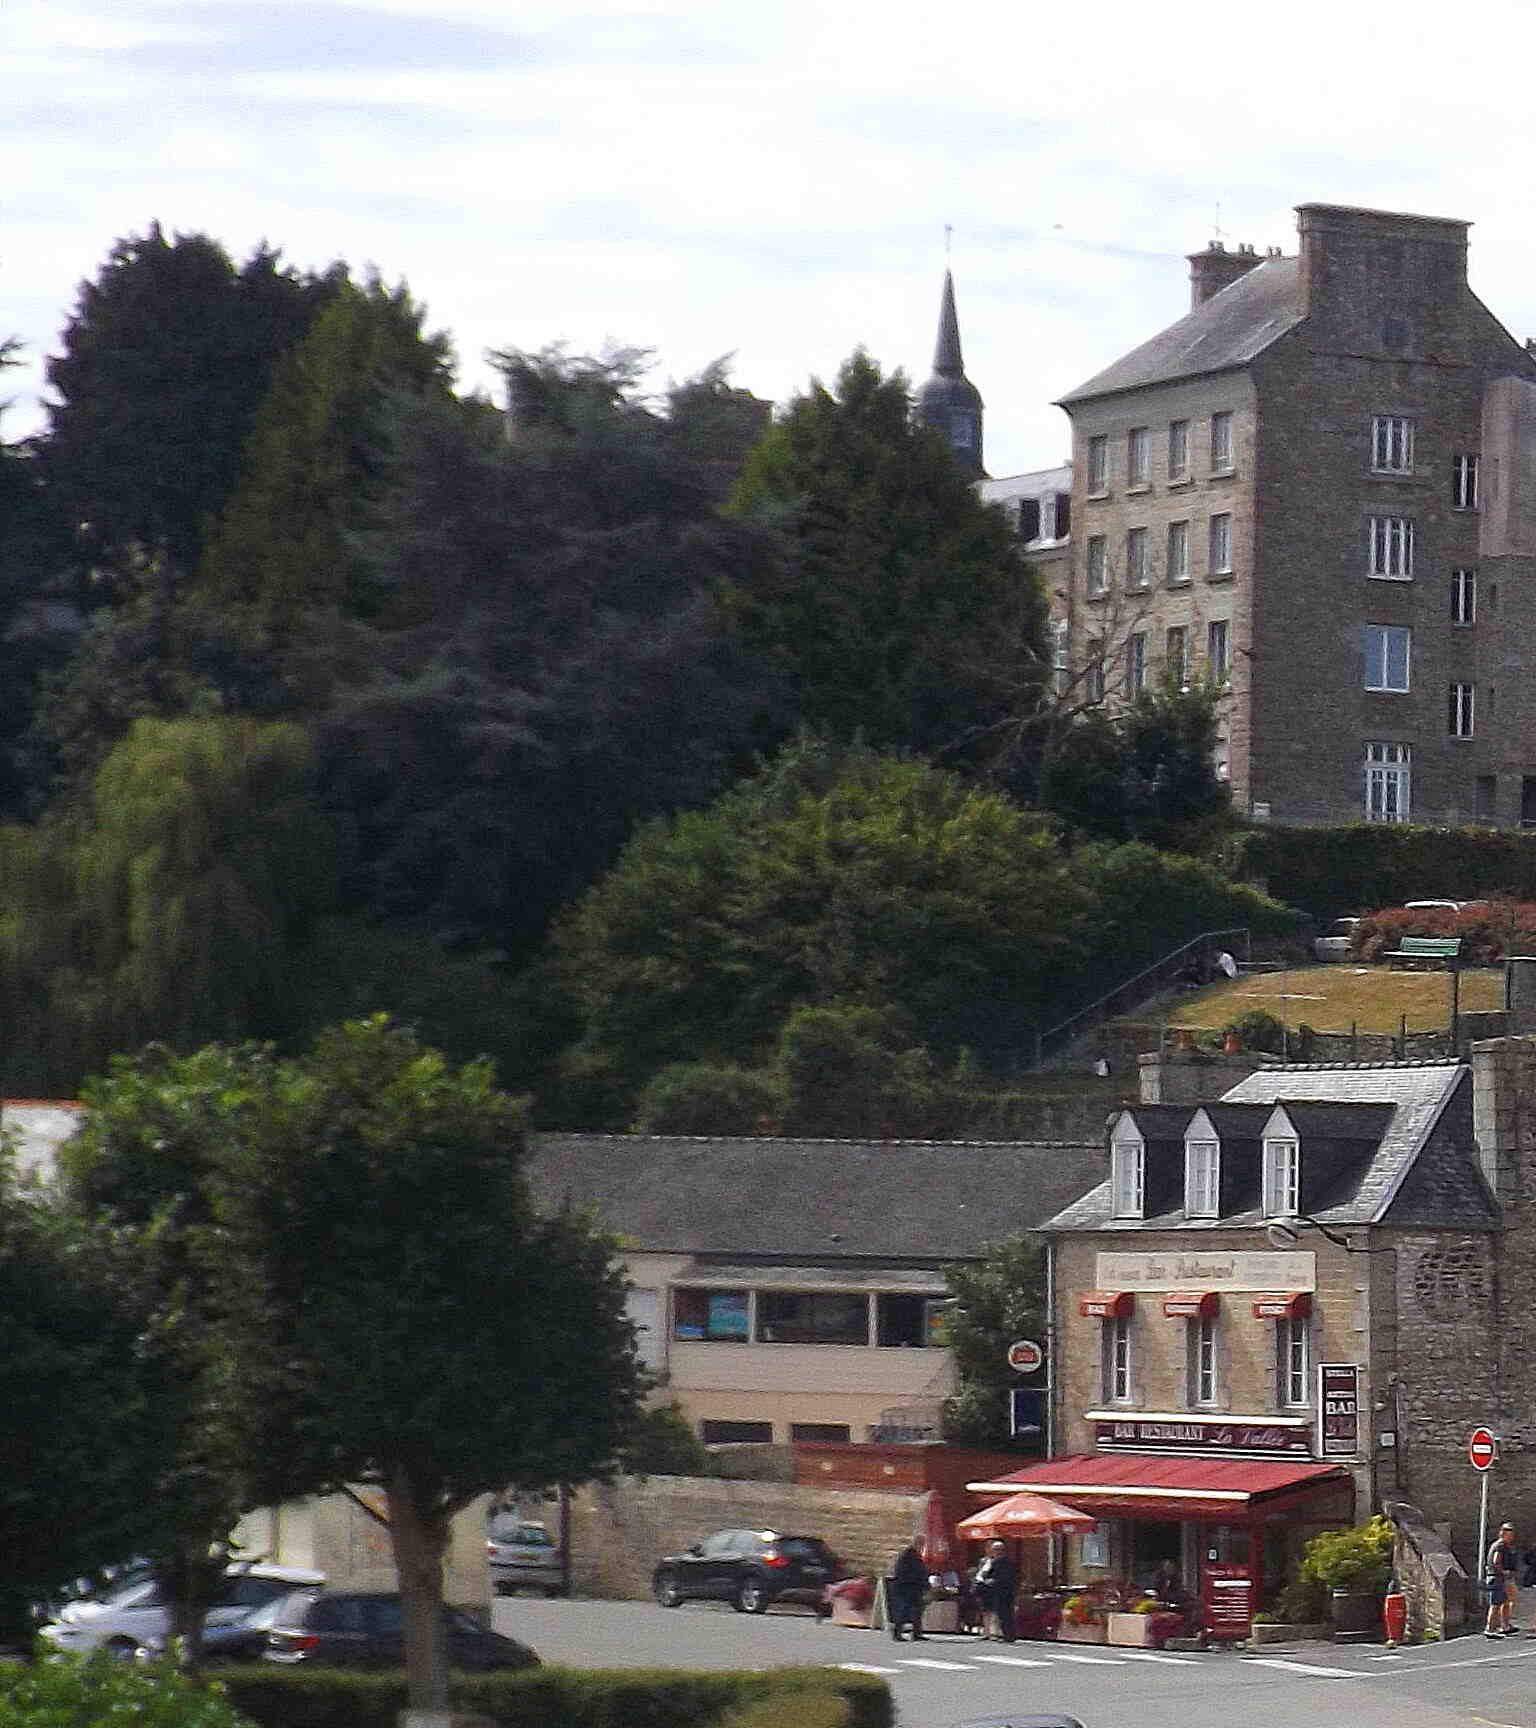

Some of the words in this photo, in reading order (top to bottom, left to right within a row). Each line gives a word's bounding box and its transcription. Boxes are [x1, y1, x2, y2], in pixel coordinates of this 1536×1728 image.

[1326, 1401, 1356, 1416] BAR
[1114, 1422, 1135, 1438] BAR
[1140, 1423, 1203, 1440] RESTAURANT
